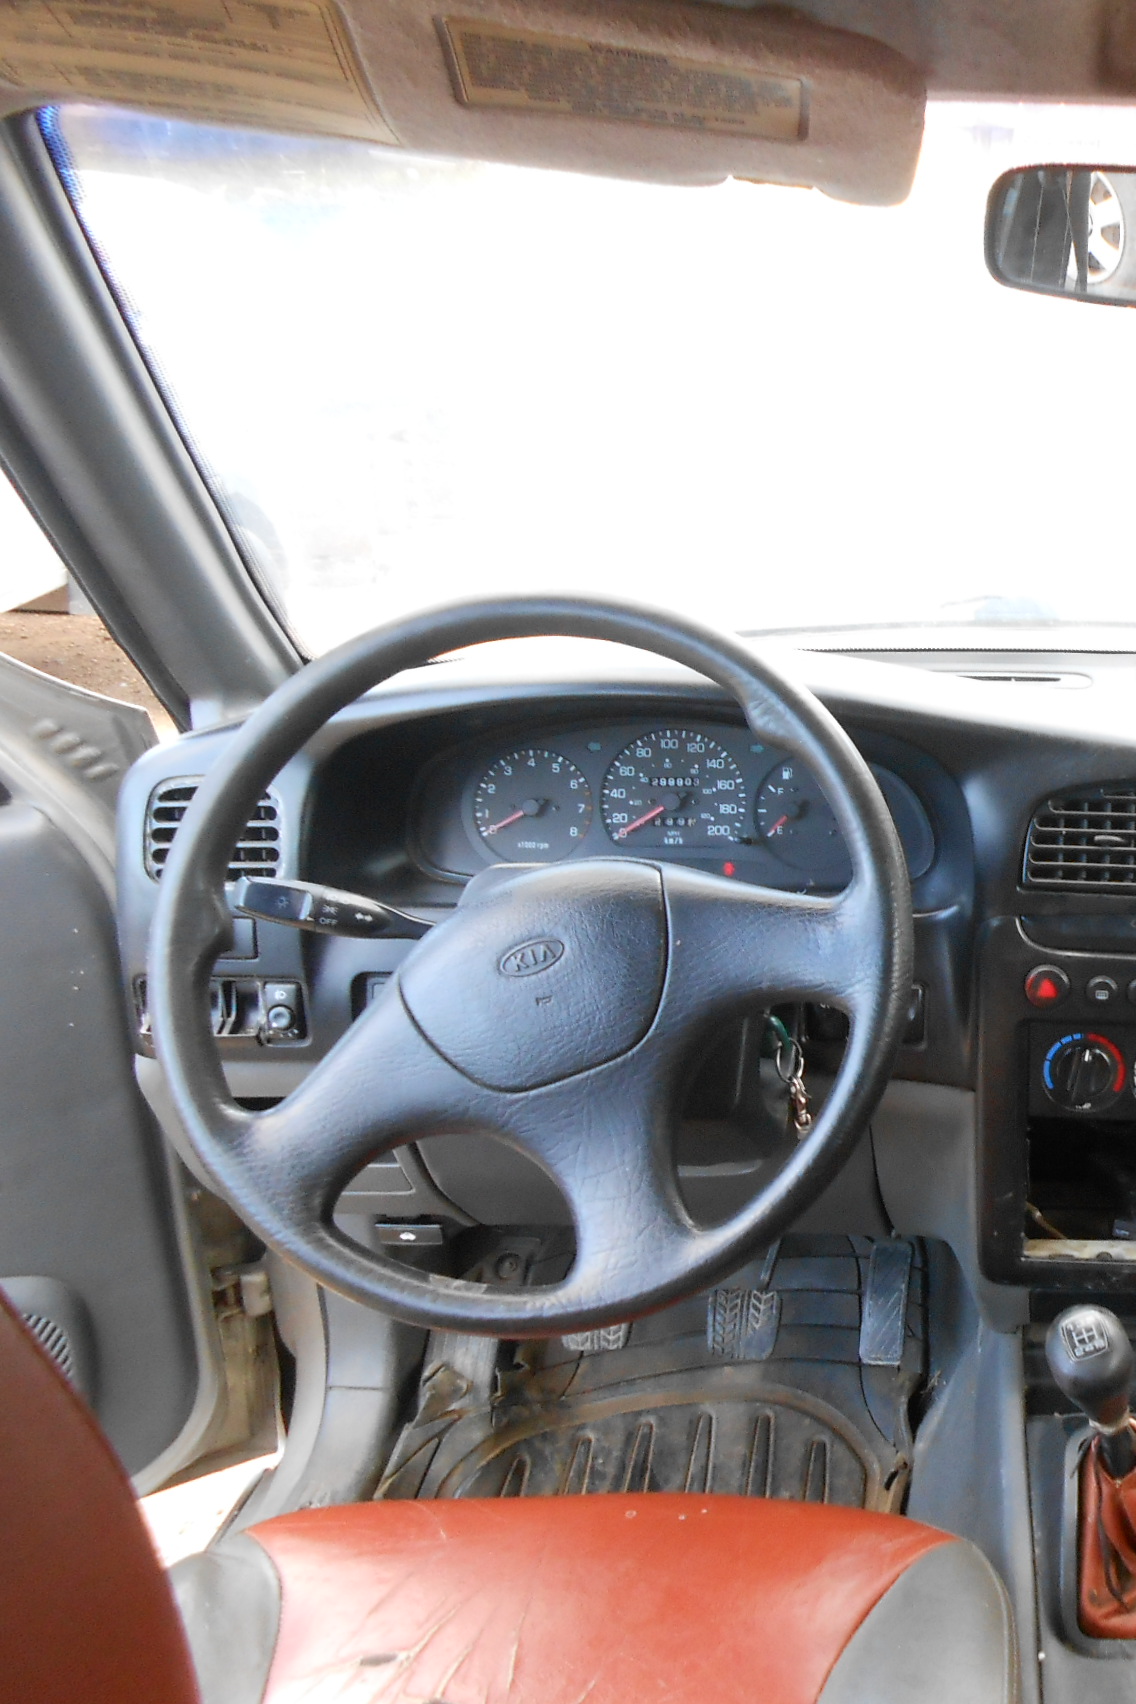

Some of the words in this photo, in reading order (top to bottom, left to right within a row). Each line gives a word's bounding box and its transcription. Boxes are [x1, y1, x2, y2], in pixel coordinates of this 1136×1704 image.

[661, 739, 679, 749] 100
[687, 743, 705, 753] 120
[636, 747, 652, 758] 80
[527, 758, 536, 767] 4
[706, 759, 725, 769] 140
[504, 766, 512, 776] 3
[552, 763, 561, 773] 5
[619, 766, 635, 777] 60
[487, 784, 496, 794] 2
[570, 780, 578, 789] 6
[717, 780, 735, 791] 160
[610, 788, 626, 799] 40
[777, 787, 784, 795] F
[484, 809, 489, 818] 1
[577, 804, 585, 813] 7
[719, 804, 737, 815] 180
[612, 813, 628, 823] 20
[569, 827, 578, 837] 8
[707, 825, 730, 836] 200
[777, 826, 783, 835] E
[513, 944, 557, 972] KIA
